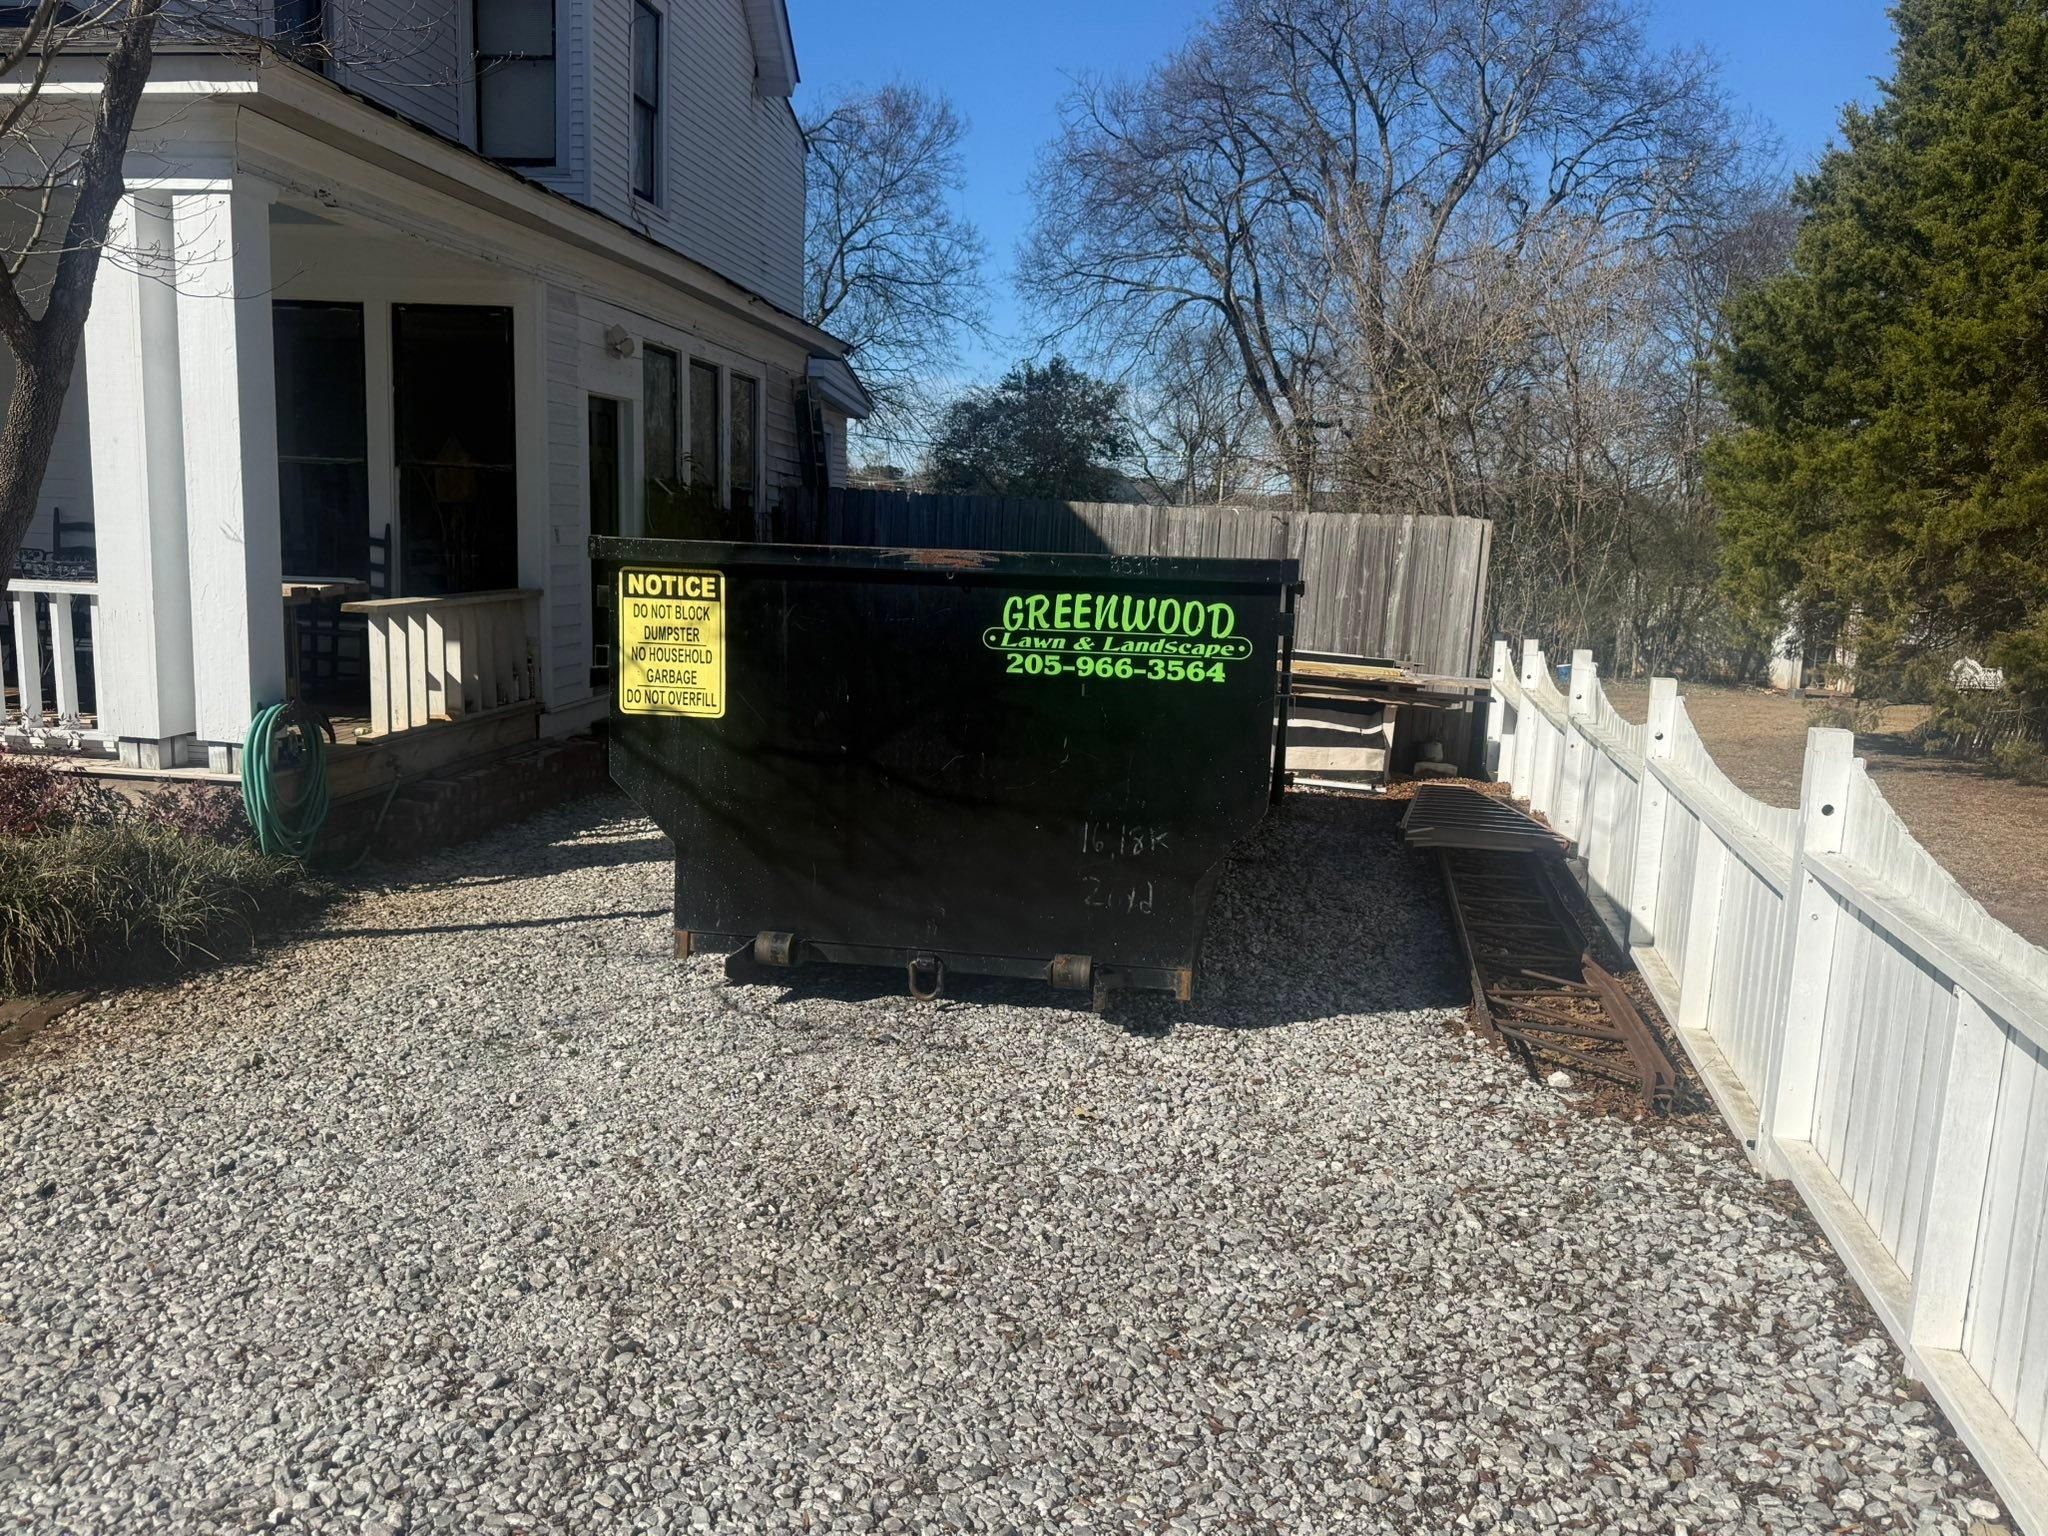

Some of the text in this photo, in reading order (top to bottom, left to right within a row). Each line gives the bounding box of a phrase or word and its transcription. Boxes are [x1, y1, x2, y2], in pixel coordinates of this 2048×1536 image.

[628, 573, 716, 598] NOTICE
[634, 603, 711, 621] DO NOT BLOCK
[1002, 593, 1235, 638] GREENWOOD
[644, 625, 700, 642] DUMPSTER
[1000, 632, 1235, 658] Lawn & Landscape
[631, 646, 713, 664] NO HOUSEHOLD
[646, 668, 697, 685] GARBAGE
[1006, 653, 1226, 683] 205-966-3564
[627, 689, 717, 708] DO NOT OVERFILL
